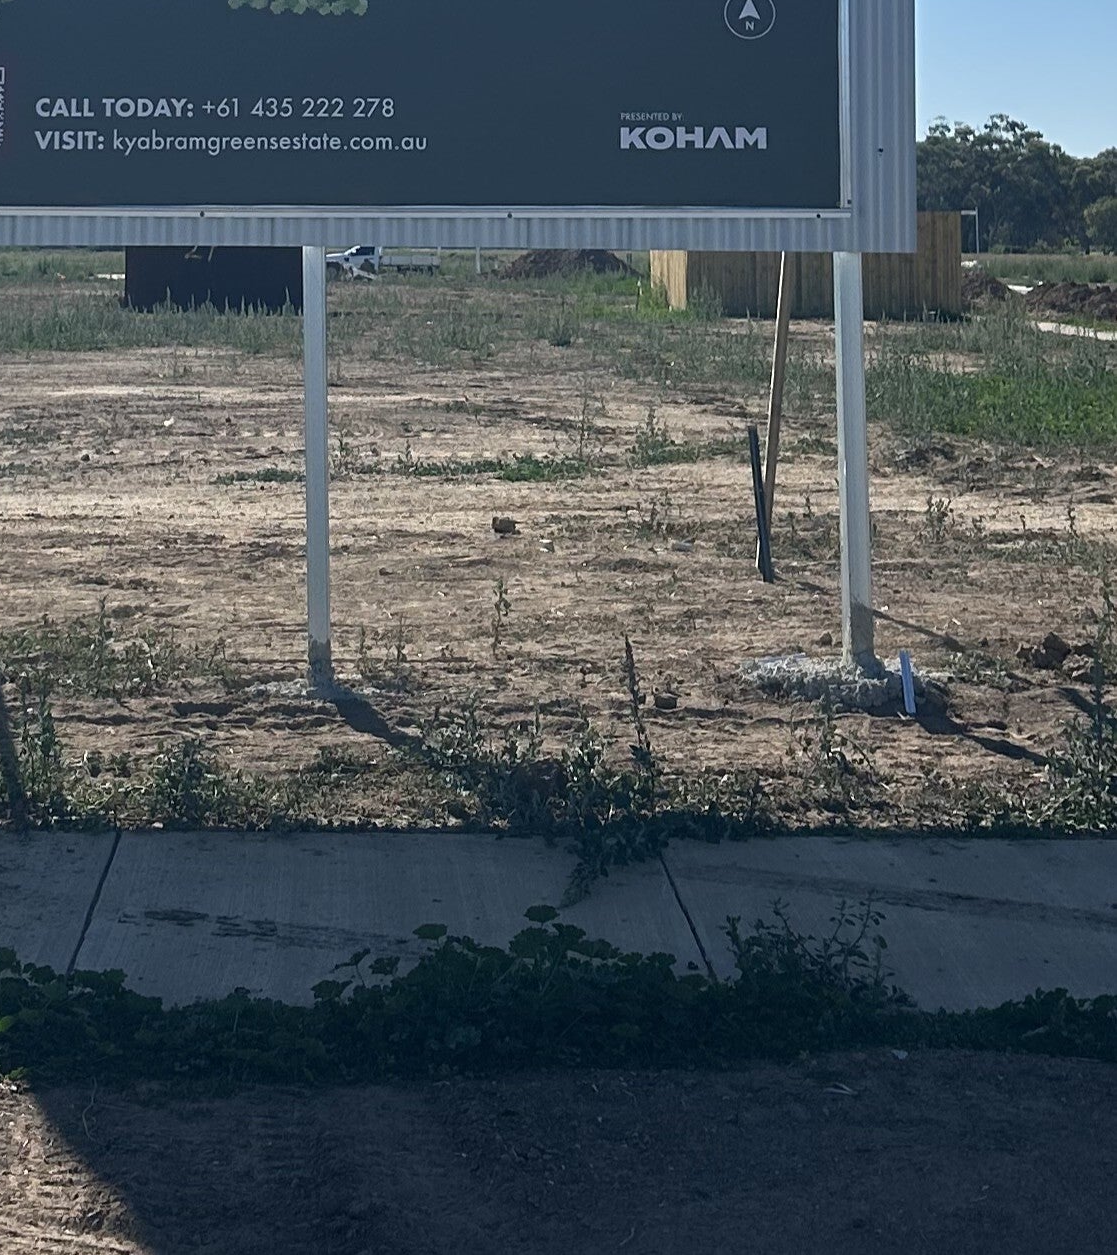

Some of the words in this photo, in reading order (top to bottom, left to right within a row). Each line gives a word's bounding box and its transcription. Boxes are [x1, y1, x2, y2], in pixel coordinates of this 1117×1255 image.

[745, 20, 755, 31] N
[35, 97, 94, 118] CALL
[101, 97, 194, 118] TODAY:
[201, 97, 239, 118] +61
[250, 97, 293, 118] 435
[301, 97, 344, 118] 222
[352, 97, 395, 118] 278
[620, 112, 670, 122] PRESENTED
[671, 112, 684, 121] BY
[34, 130, 105, 150] VISIT:
[113, 128, 427, 156] kyabramgreensestate.com.au
[620, 126, 767, 150] KOHAM
